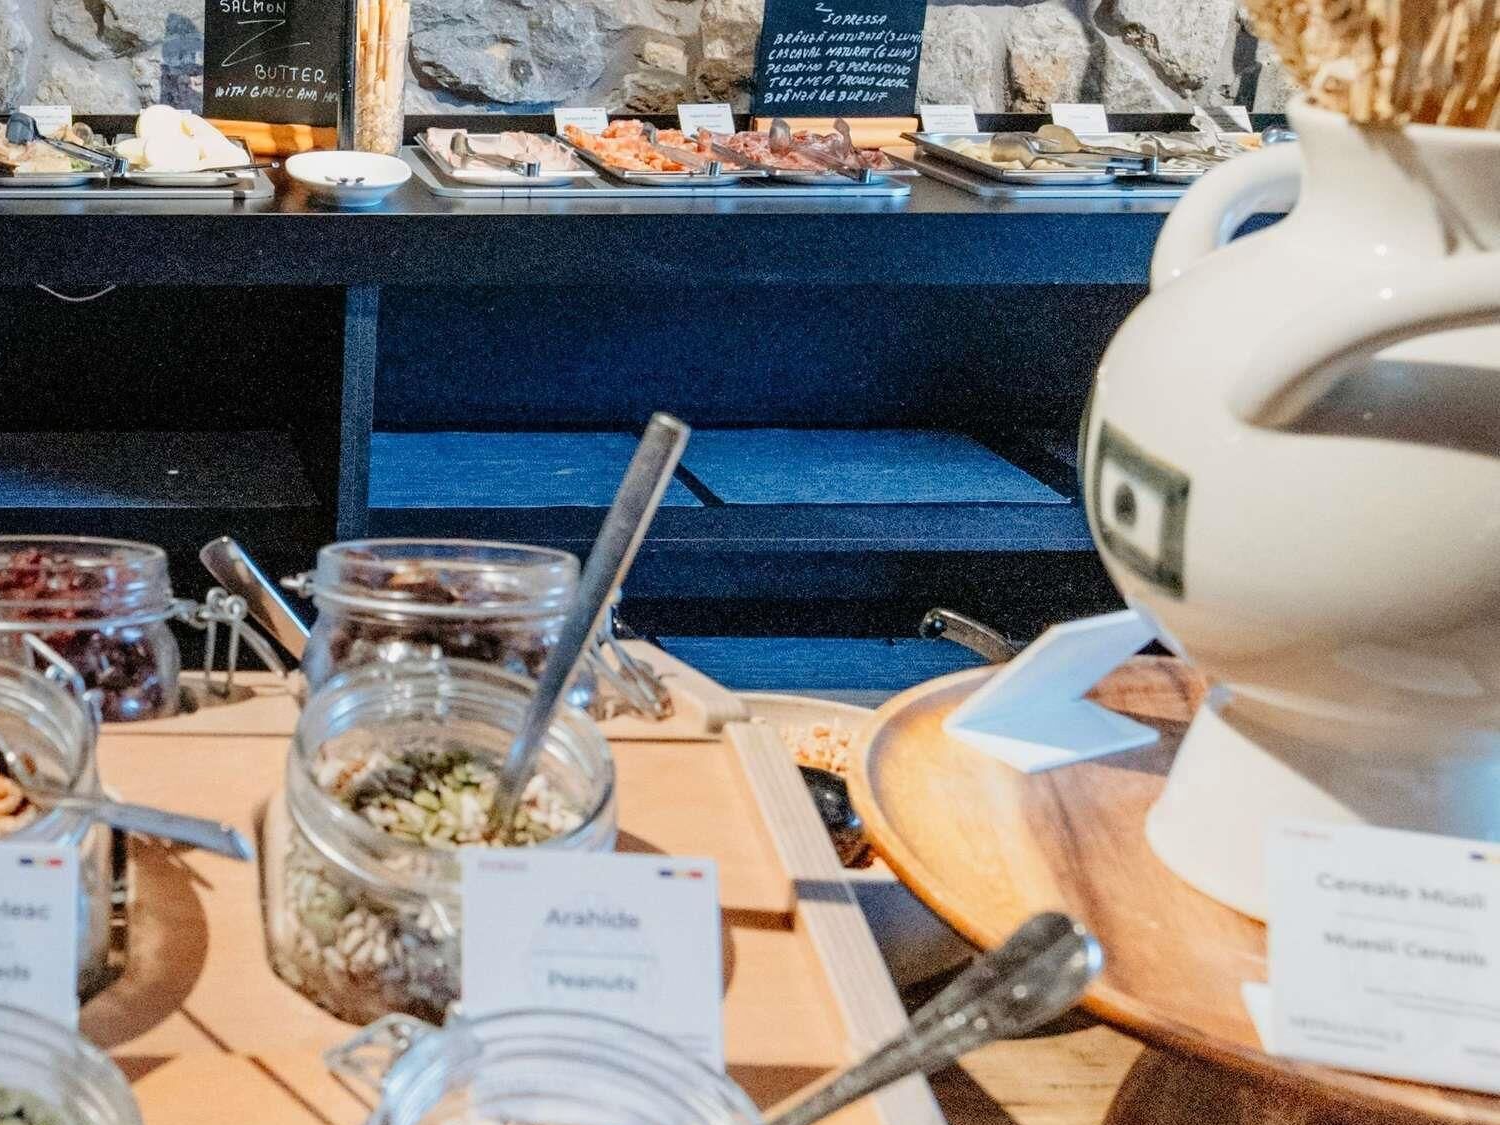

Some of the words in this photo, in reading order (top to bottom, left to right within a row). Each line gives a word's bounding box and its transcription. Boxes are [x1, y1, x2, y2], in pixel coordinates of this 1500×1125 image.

[219, 0, 286, 14] SALMON
[823, 13, 887, 25] SOPRESSA
[768, 46, 821, 60] CASCAVAL
[254, 64, 326, 84] BUTTER
[250, 85, 294, 98] GARLIC
[296, 87, 317, 101] AND
[1316, 871, 1412, 900] Cereale
[543, 907, 641, 930] Arahide
[1323, 932, 1397, 956] Muesli
[1403, 942, 1487, 966] Cereals
[547, 970, 637, 990] Peanuts
